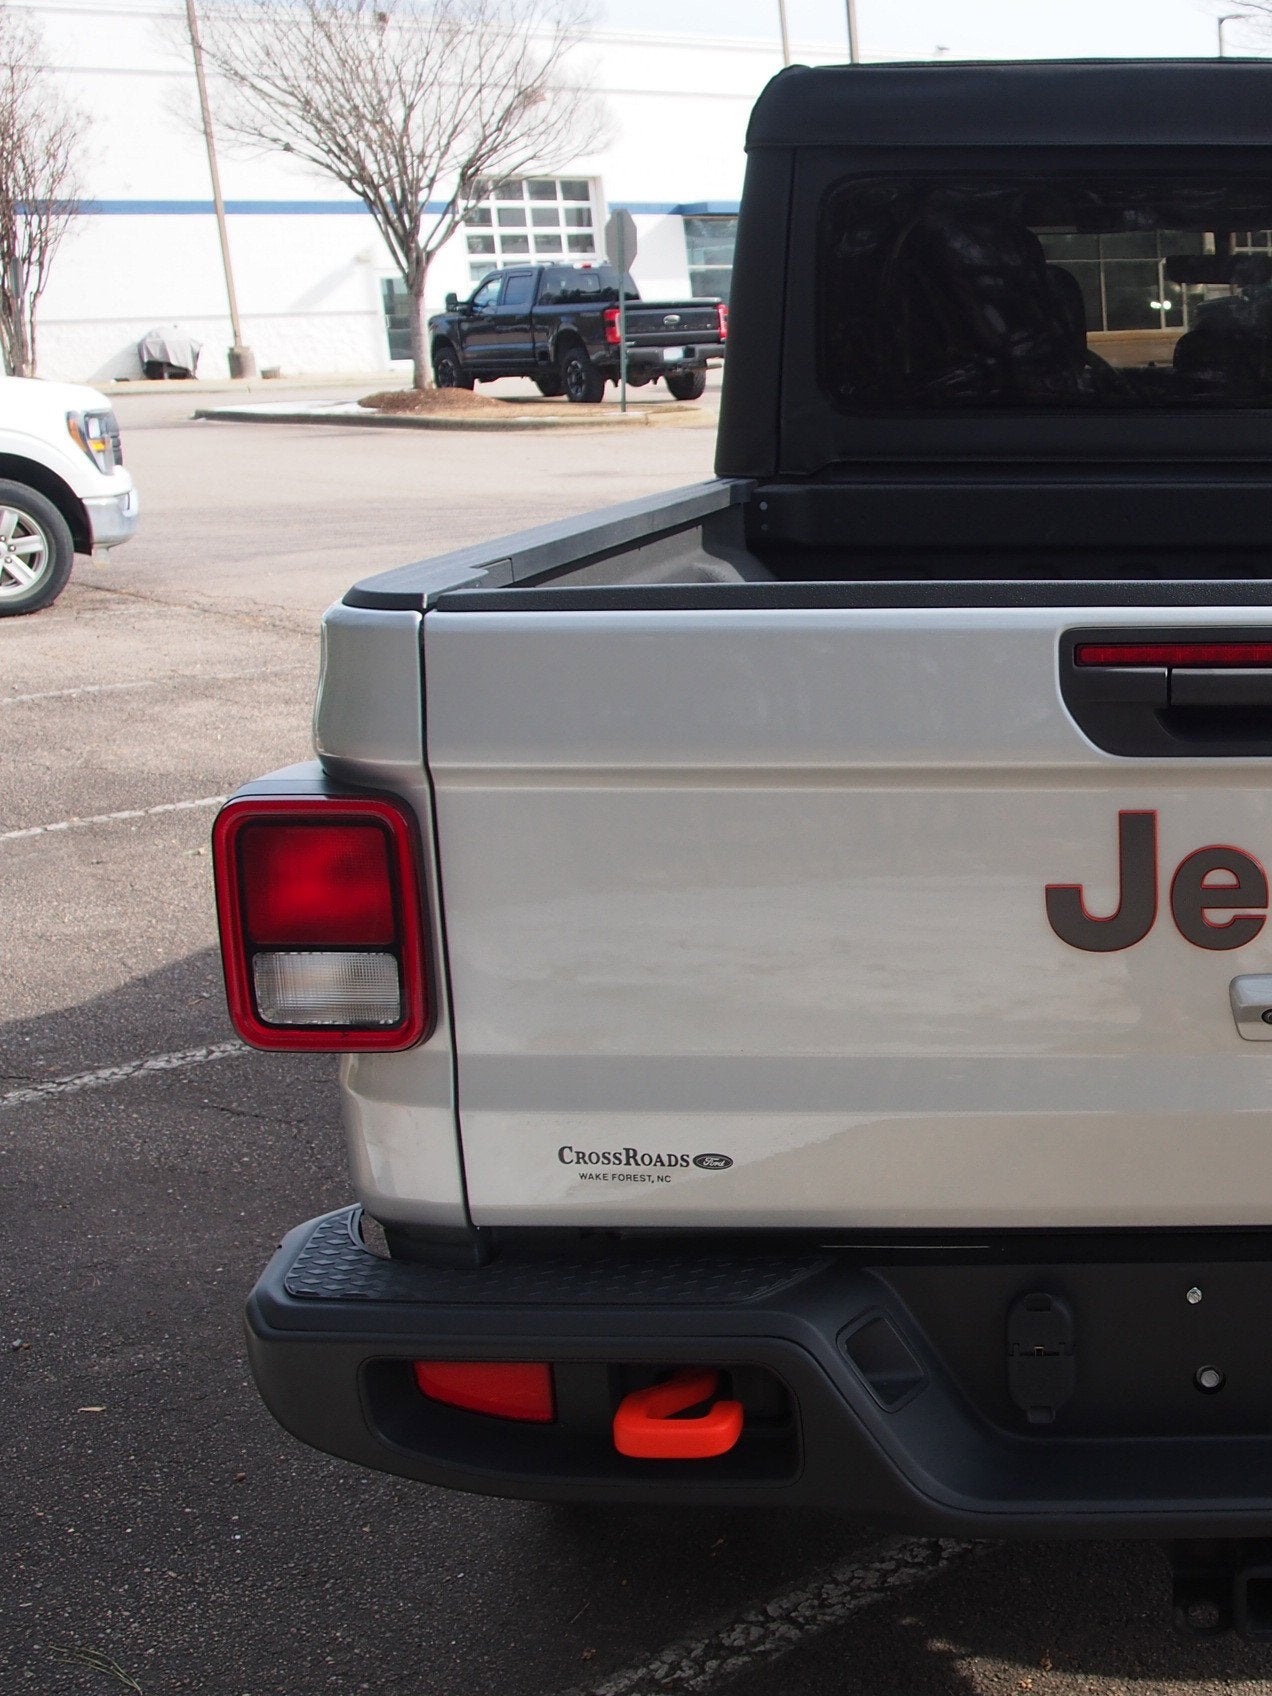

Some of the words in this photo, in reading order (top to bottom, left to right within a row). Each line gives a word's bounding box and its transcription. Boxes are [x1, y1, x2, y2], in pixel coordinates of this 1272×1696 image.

[578, 1172, 609, 1181] WAKE
[612, 1173, 655, 1183] FOREST,
[657, 1175, 671, 1183] NC
